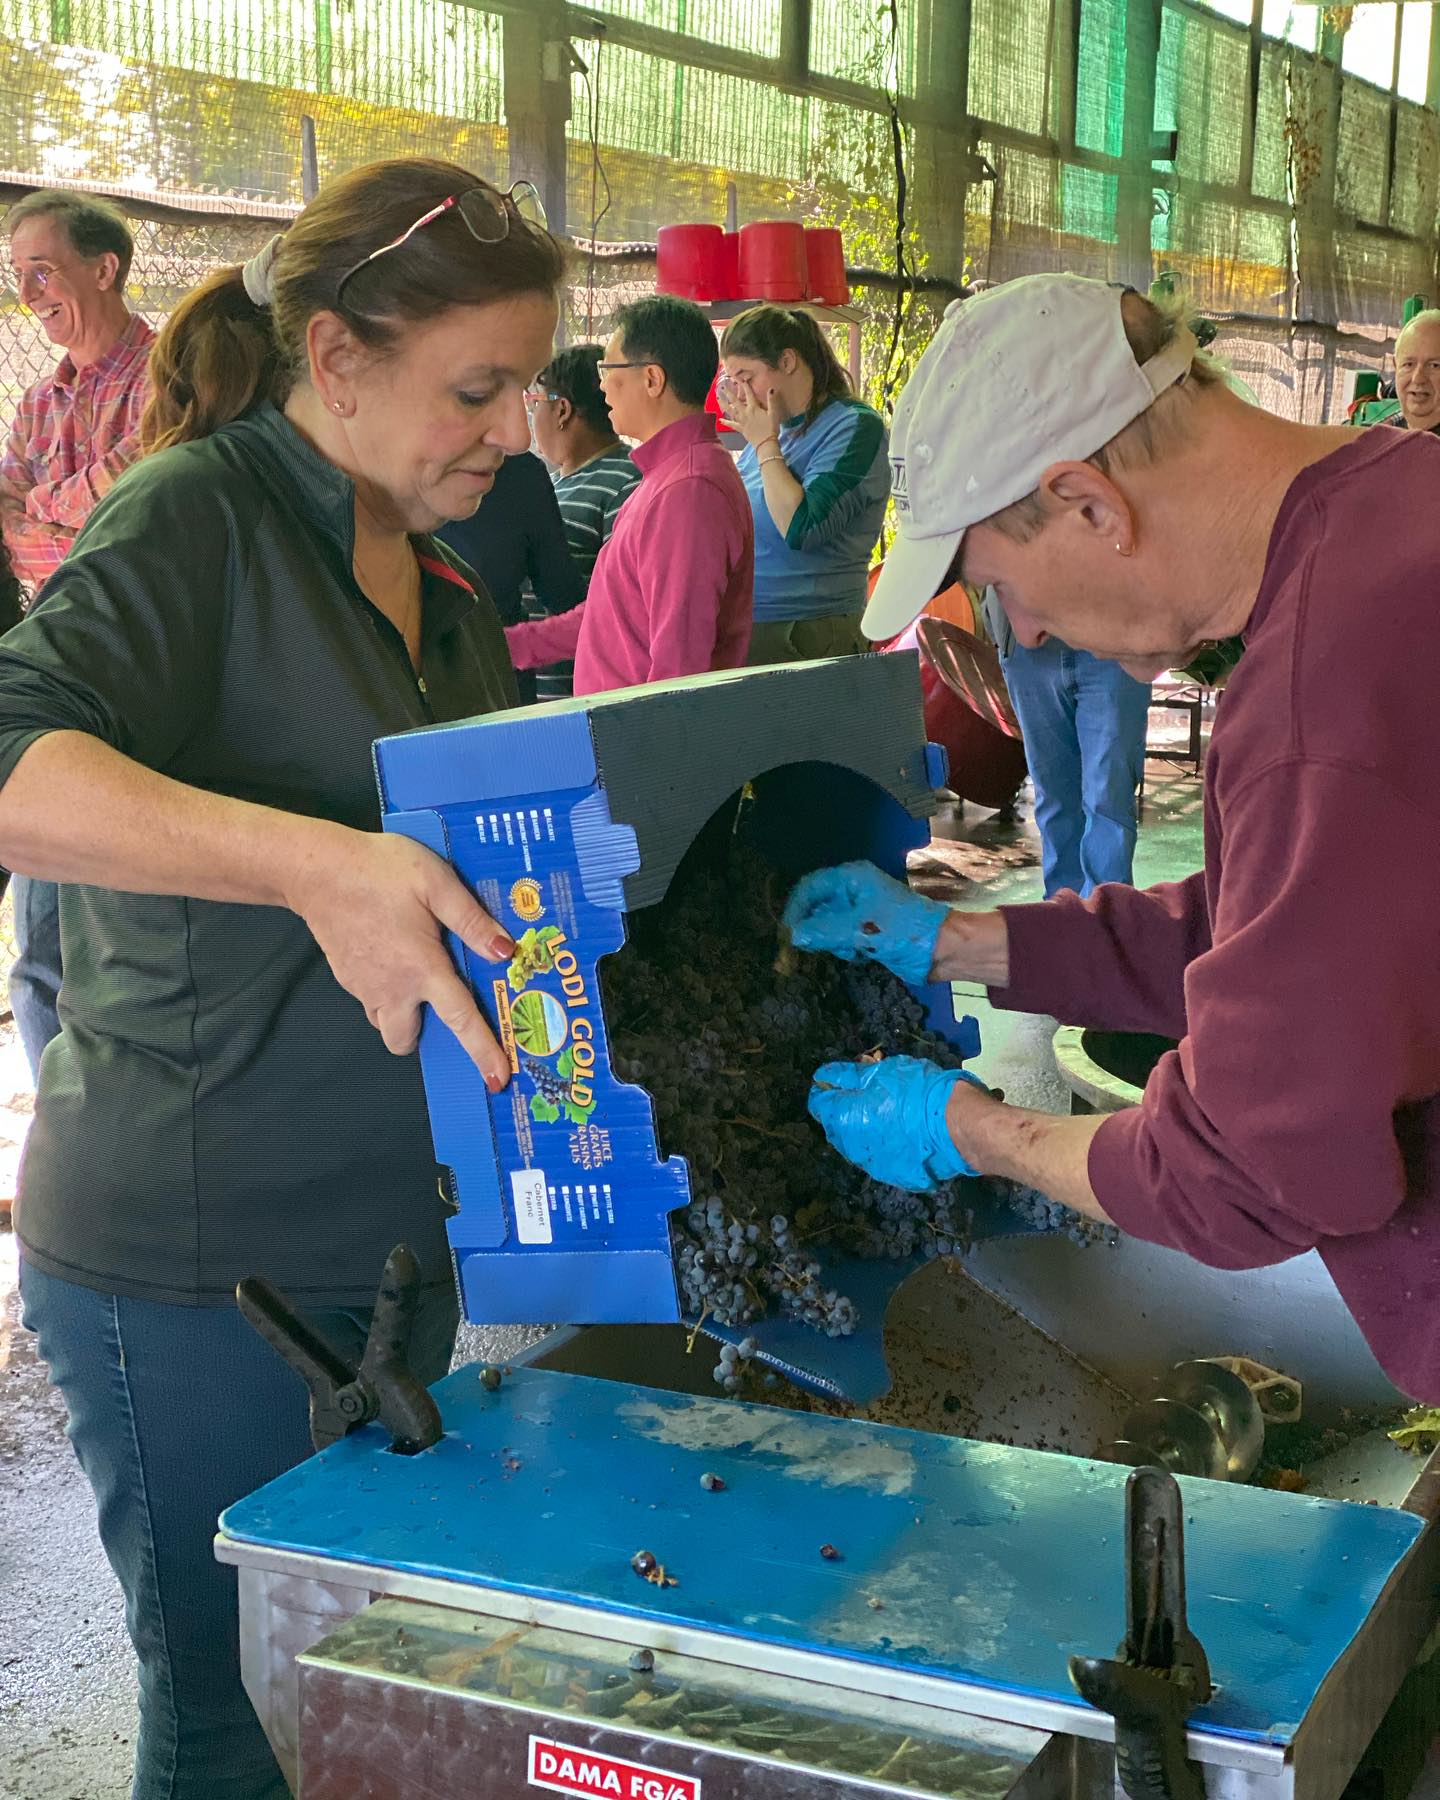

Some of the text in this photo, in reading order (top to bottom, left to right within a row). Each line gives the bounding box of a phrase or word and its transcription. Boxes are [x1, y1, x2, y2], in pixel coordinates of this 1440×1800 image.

[478, 824, 487, 843] MERLOT
[491, 823, 500, 842] MALBEC
[518, 819, 528, 844] CABERNET
[546, 817, 556, 841] ALICANTE
[496, 983, 507, 1020] Premium
[502, 1022, 511, 1040] Wine
[546, 933, 589, 1008] LODI
[570, 1017, 595, 1107] GOLD
[569, 1133, 581, 1164] A JUS
[577, 1125, 592, 1171] RAISINS
[588, 1124, 604, 1168] GRAPES
[598, 1129, 613, 1162] JUICE
[525, 1191, 533, 1218] Franc
[534, 1182, 545, 1226] Cabernet
[579, 1206, 588, 1229] CABERNET
[540, 1752, 688, 1800] DAMA FG/6
